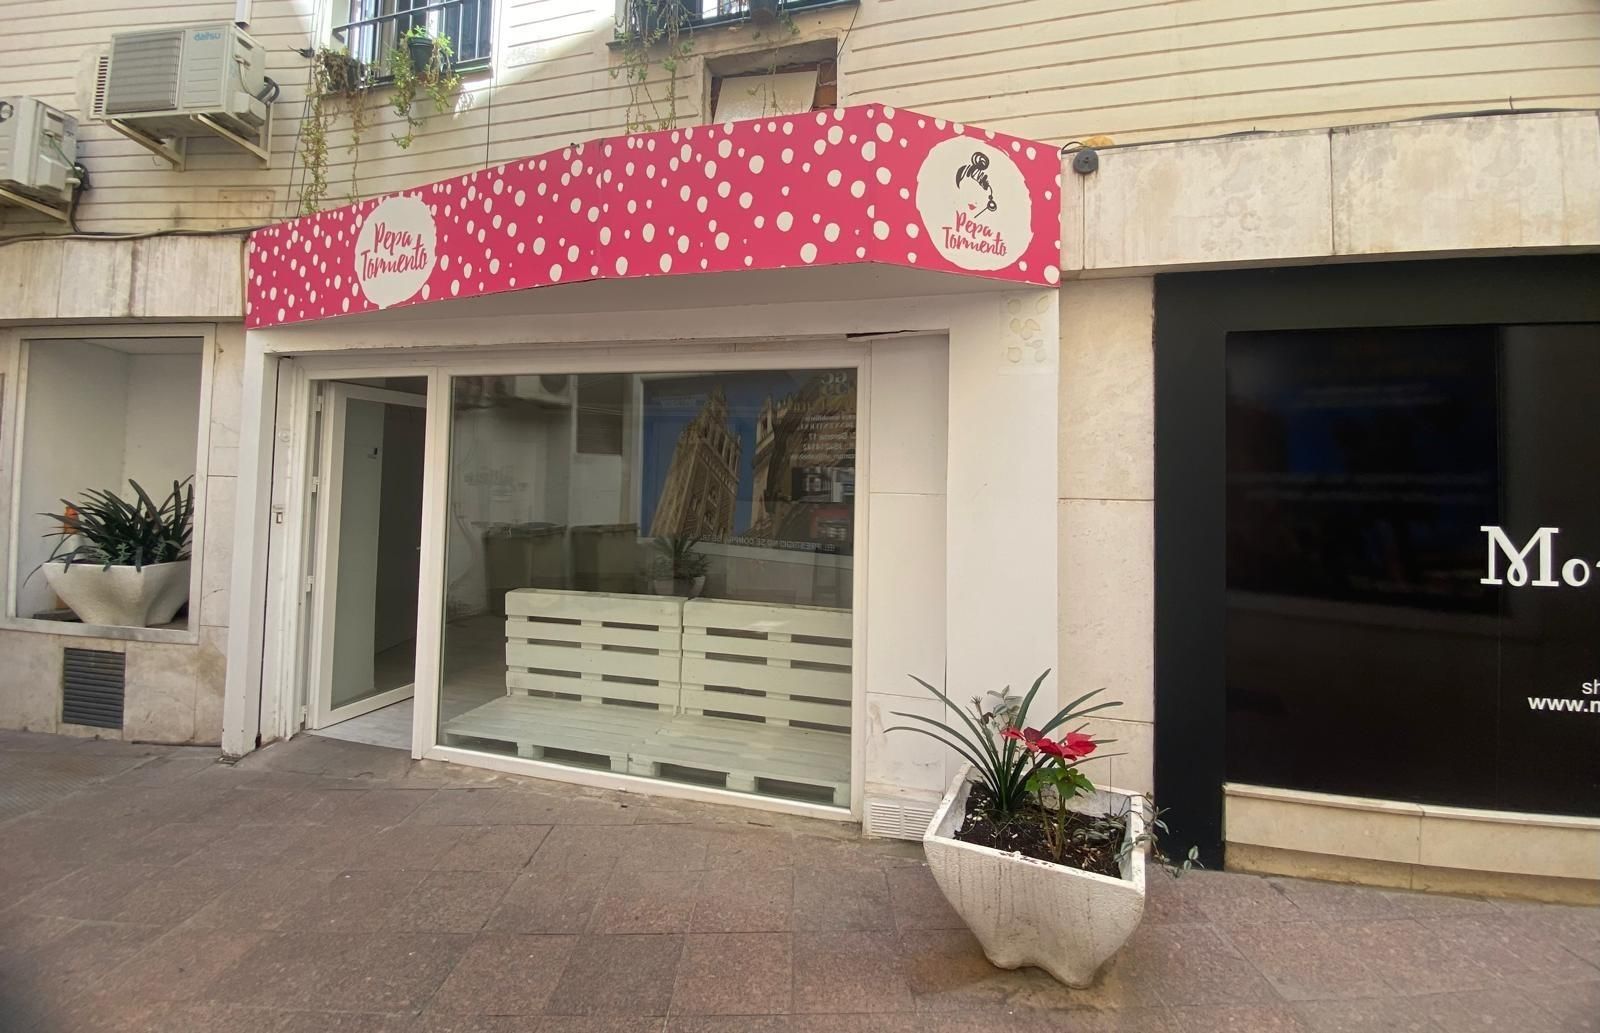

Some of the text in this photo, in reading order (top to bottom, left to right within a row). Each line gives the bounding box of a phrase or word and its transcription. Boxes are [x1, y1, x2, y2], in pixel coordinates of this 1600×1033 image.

[374, 222, 413, 256] Pepa
[942, 226, 1007, 256] Tormento
[955, 210, 993, 239] Pepa
[360, 234, 427, 281] Tormento
[1480, 525, 1600, 587] Mo
